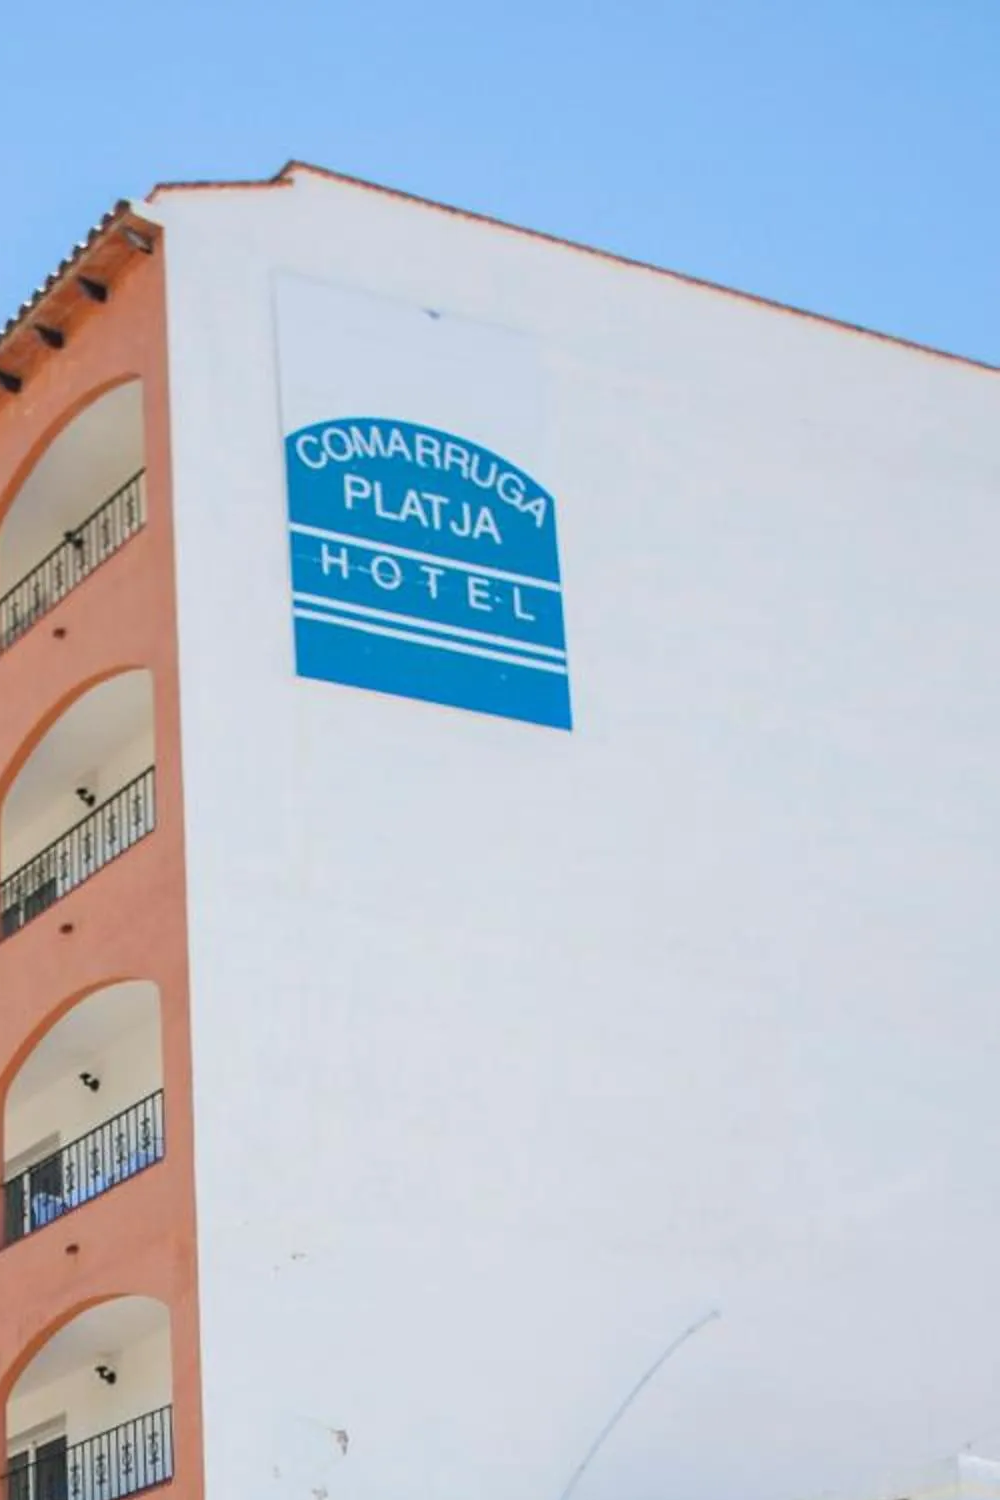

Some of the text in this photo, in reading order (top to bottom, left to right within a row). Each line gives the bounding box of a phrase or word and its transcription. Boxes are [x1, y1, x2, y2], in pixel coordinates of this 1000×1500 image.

[296, 426, 547, 528] COMARRUGA
[344, 473, 502, 544] PLATJA
[321, 543, 536, 621] HOTEL
